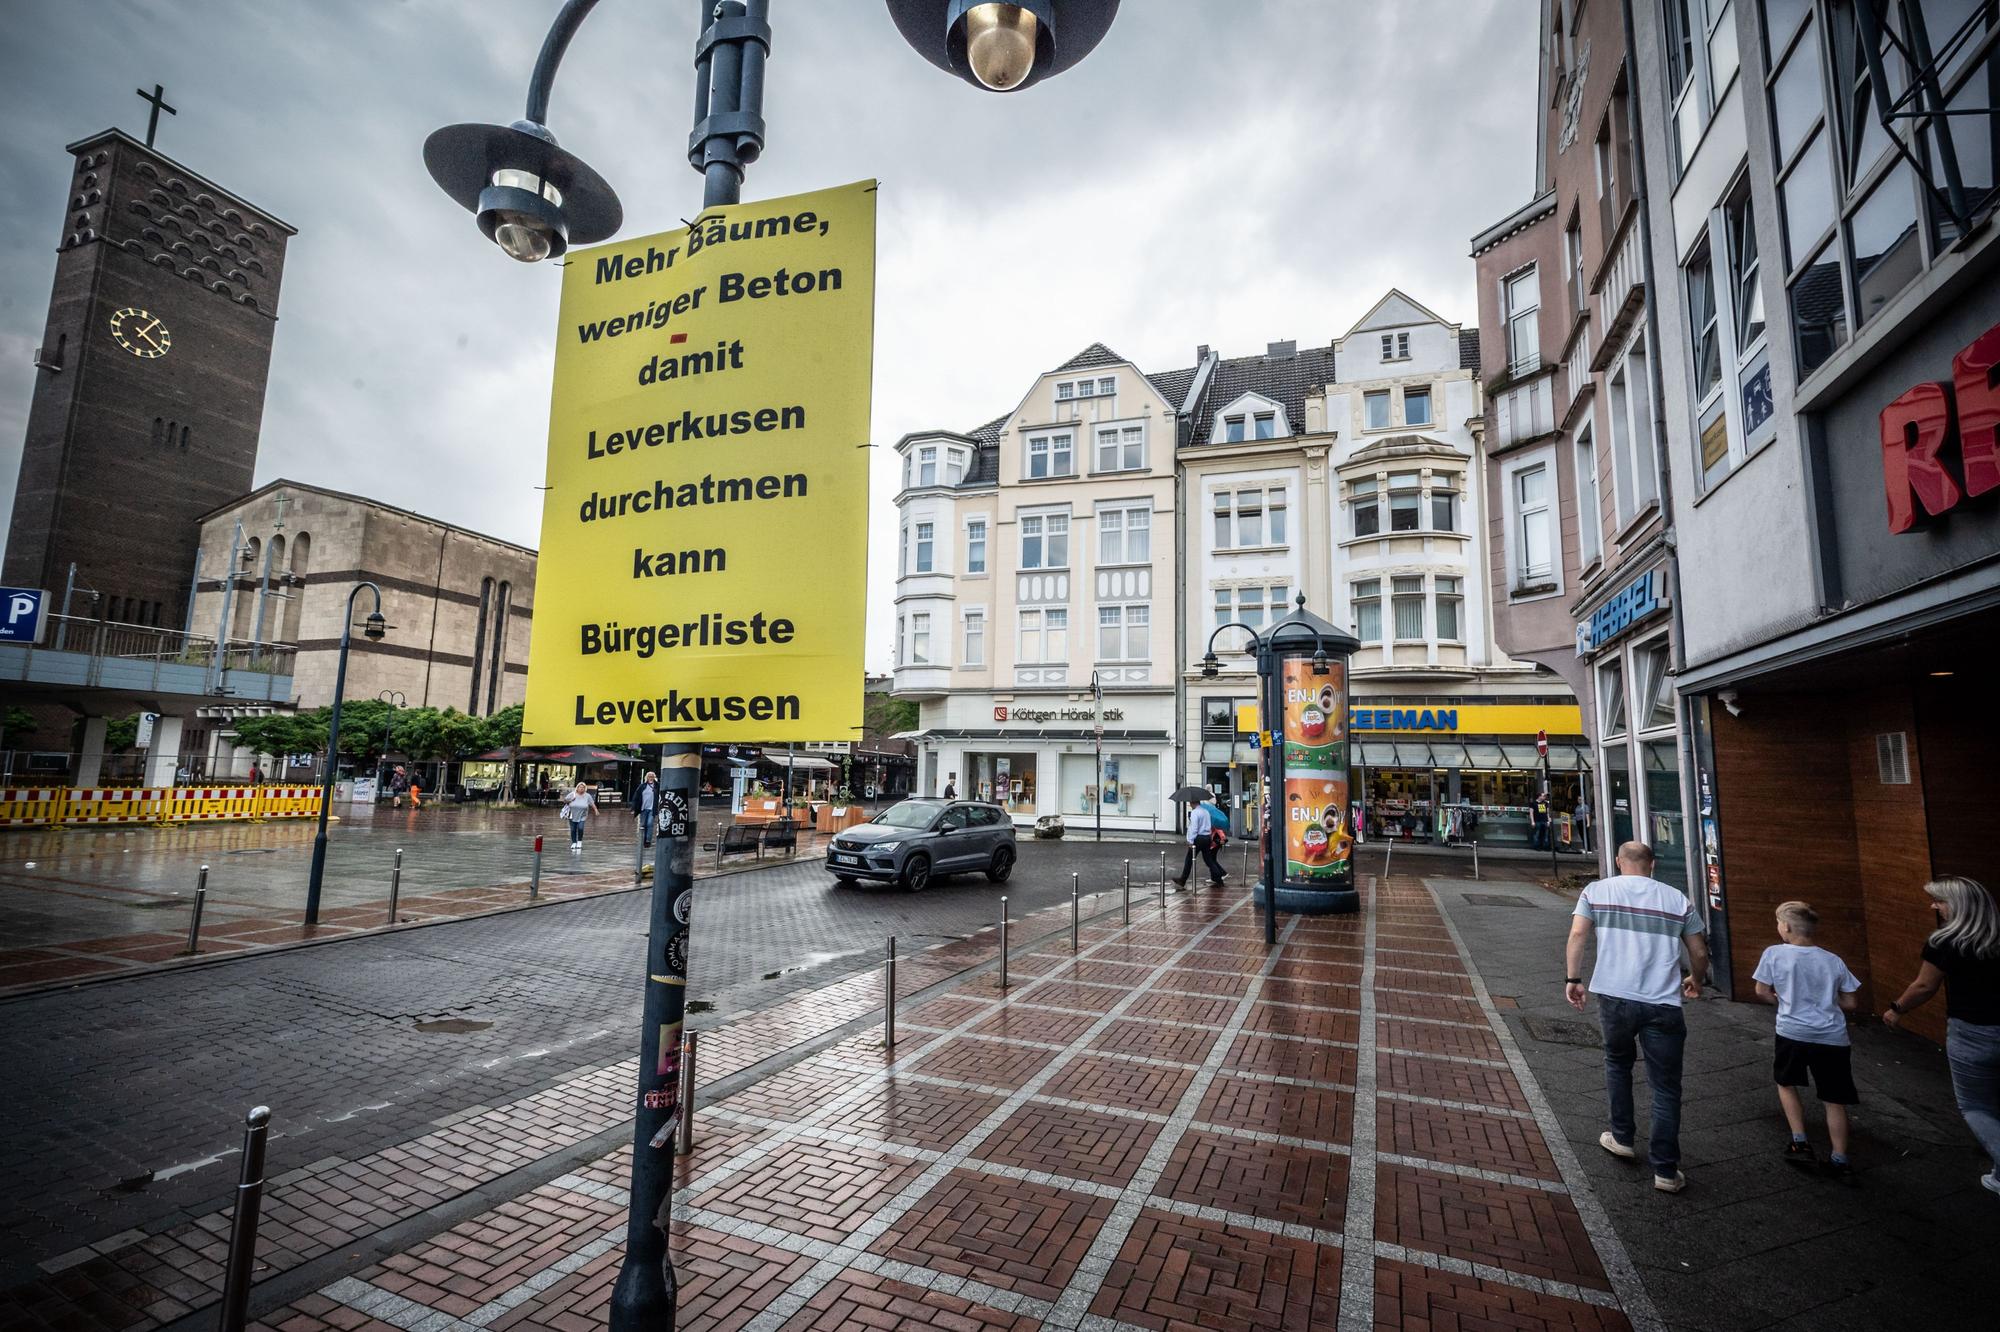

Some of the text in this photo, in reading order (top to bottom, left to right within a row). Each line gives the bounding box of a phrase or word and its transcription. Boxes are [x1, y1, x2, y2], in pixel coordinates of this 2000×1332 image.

[595, 211, 830, 285] Mehr Bäume,
[578, 267, 842, 343] weniger Beton
[638, 339, 744, 386] damit
[587, 405, 805, 460] Leverkusen
[579, 473, 808, 523] durchatmen
[633, 547, 726, 579] kann
[581, 612, 795, 658] Bürgerliste
[575, 690, 800, 726] Leverkusen
[1012, 708, 1123, 723] Köttgen Hörakstik
